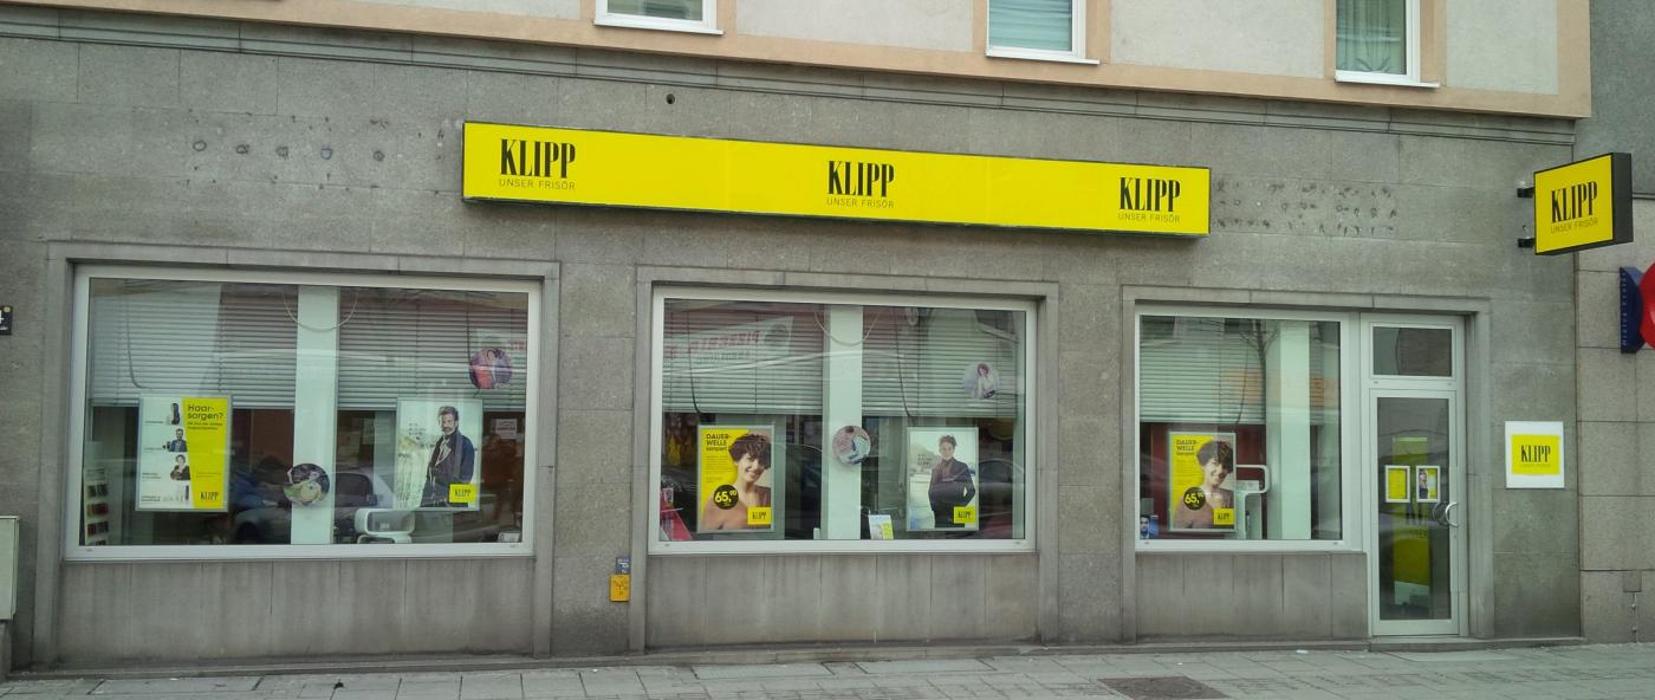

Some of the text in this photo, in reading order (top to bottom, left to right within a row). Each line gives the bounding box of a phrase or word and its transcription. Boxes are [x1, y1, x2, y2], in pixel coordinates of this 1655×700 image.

[500, 138, 576, 179] KLIPP
[499, 178, 576, 191] UNSER FRISÖR
[827, 160, 895, 198] KLIPP
[1119, 176, 1181, 212] KLIPP
[826, 197, 895, 209] UNSER FRISÖR
[1551, 181, 1597, 223] KLIPP
[1118, 212, 1181, 224] UNSER FRISÖR
[1551, 221, 1573, 234] UNSER
[187, 404, 215, 412] Haar-
[187, 411, 224, 421] sorgen?
[1520, 444, 1551, 463] KLIPP
[200, 491, 219, 501] KLIPP
